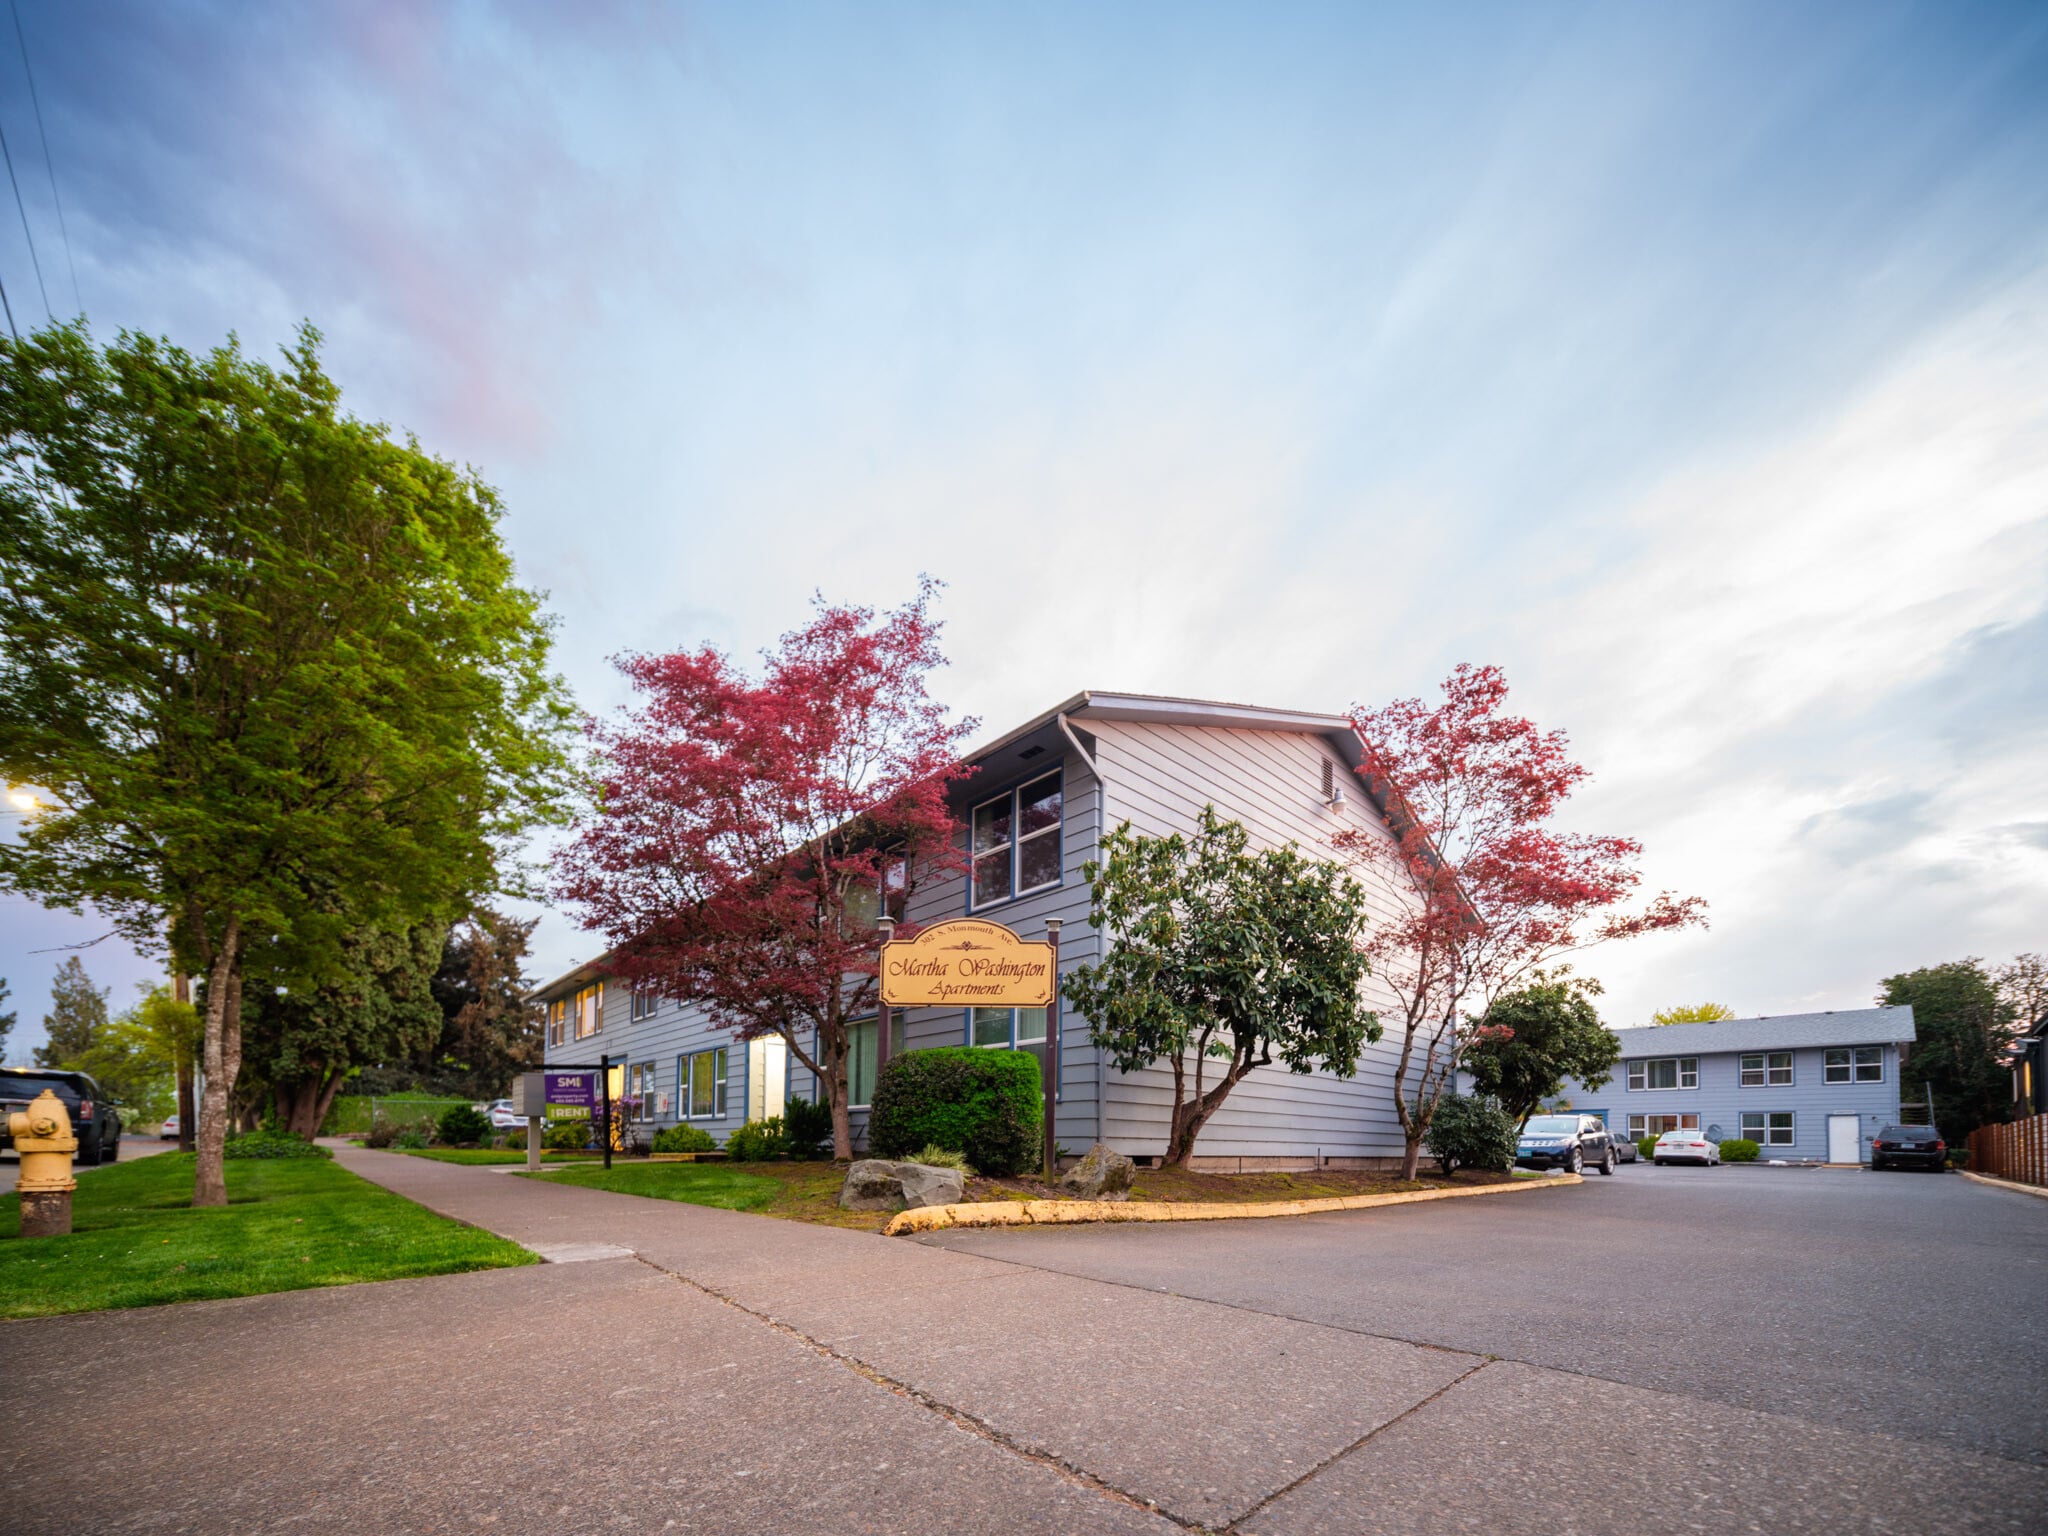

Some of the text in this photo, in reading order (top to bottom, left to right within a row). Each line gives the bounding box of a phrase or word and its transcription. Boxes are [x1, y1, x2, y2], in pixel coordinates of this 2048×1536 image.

[947, 925, 994, 936] Monmouth
[889, 957, 1046, 984] Martha Washington
[928, 980, 1005, 1000] Apartments
[556, 1107, 589, 1118] RENT
